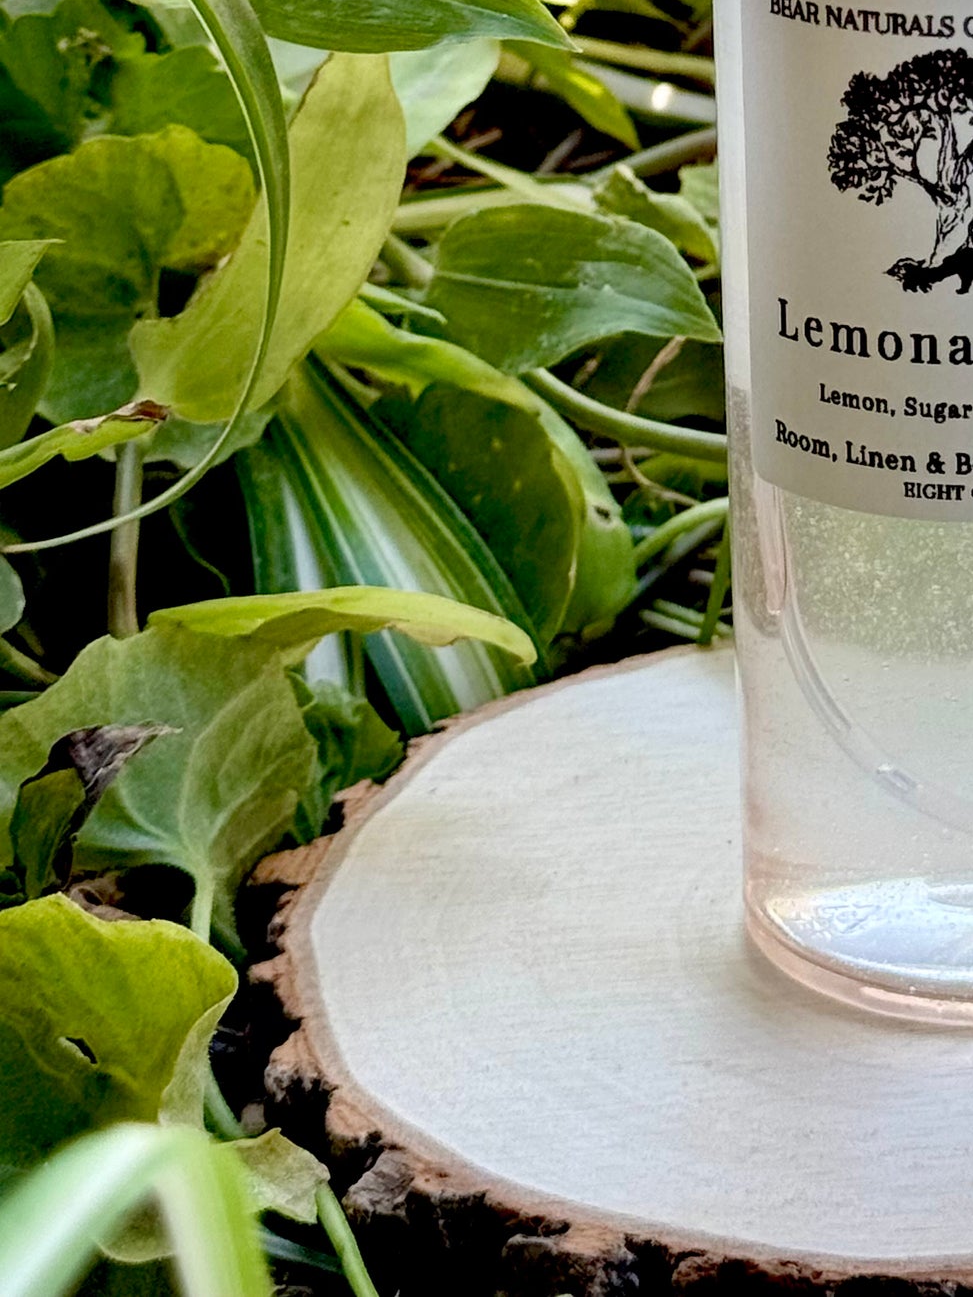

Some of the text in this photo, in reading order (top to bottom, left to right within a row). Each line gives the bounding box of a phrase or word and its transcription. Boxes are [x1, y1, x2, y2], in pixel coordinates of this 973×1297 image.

[825, 5, 955, 39] NATURALS
[819, 383, 896, 417] Lemon,
[904, 397, 972, 423] Sugar
[775, 419, 838, 463] Room,
[846, 441, 916, 473] Linen
[926, 453, 946, 475] &
[903, 481, 965, 501] EIGHT
